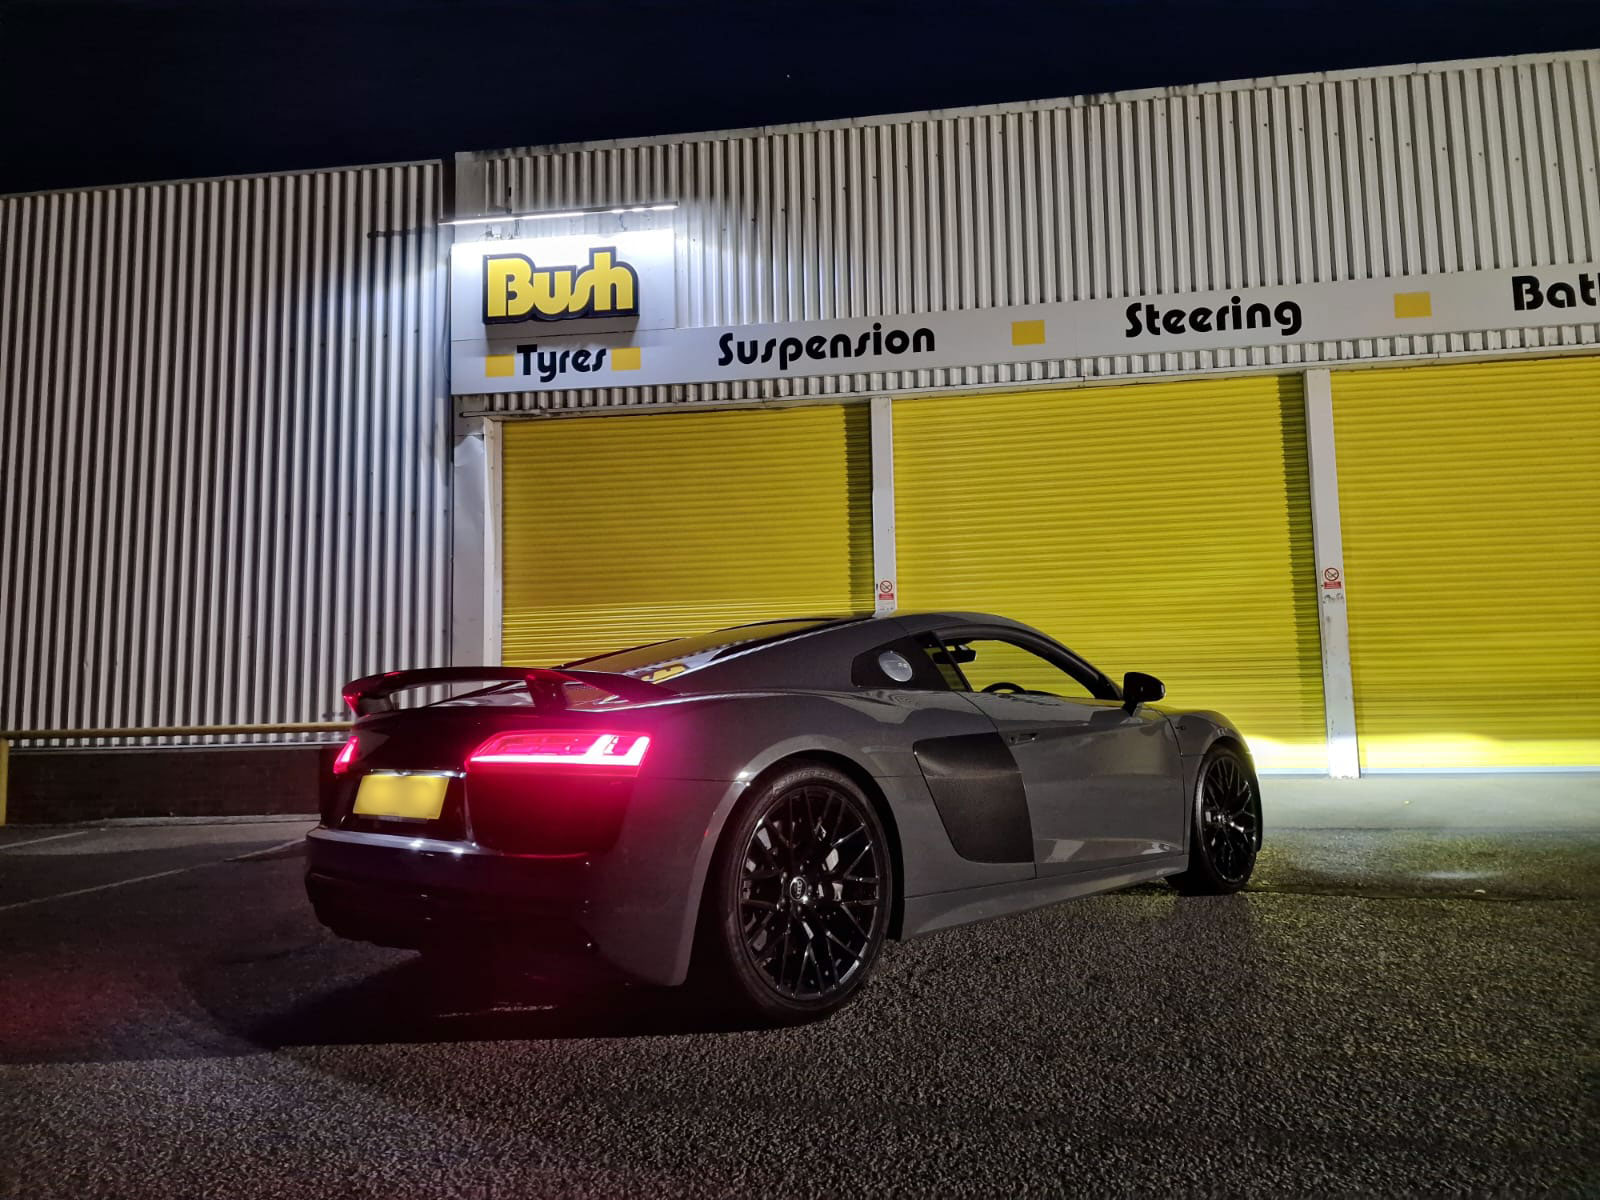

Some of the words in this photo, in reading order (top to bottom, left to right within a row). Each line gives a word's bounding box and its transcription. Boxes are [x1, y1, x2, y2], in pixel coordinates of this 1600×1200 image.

[484, 247, 638, 323] Bush
[1512, 272, 1600, 311] Bat
[1125, 295, 1302, 337] Steering
[515, 342, 607, 383] Tyres
[718, 322, 935, 371] Suspension
